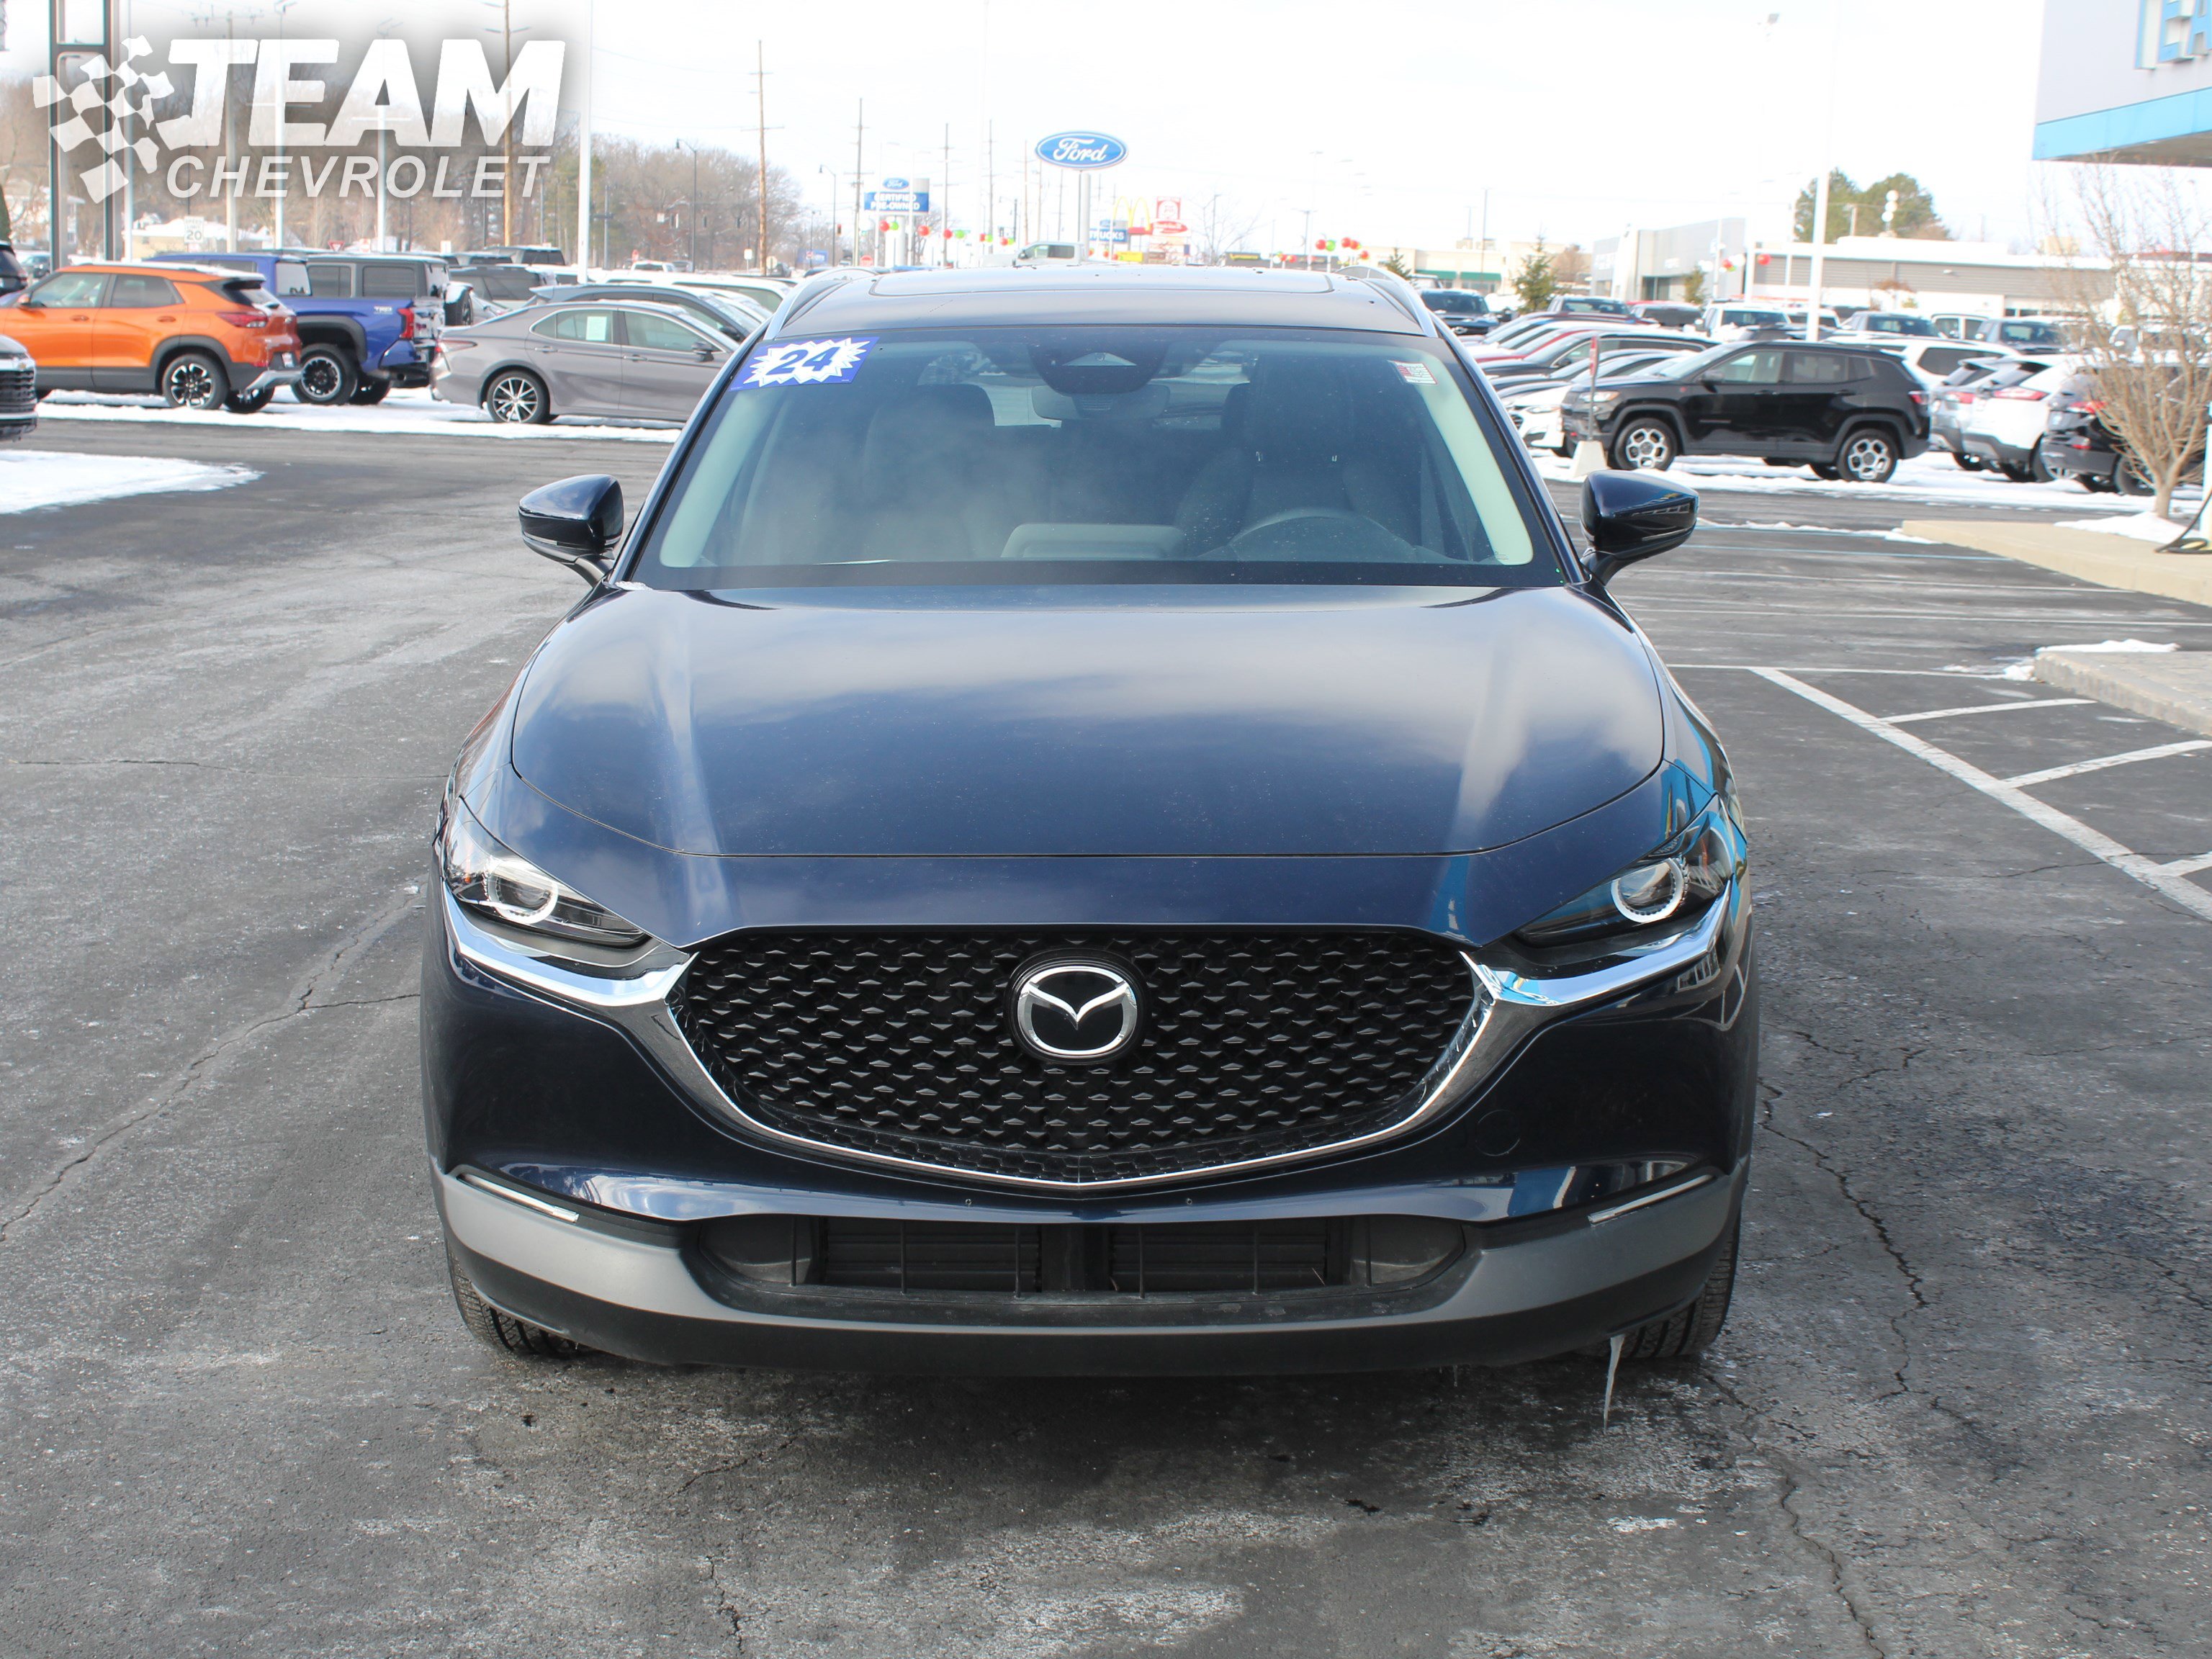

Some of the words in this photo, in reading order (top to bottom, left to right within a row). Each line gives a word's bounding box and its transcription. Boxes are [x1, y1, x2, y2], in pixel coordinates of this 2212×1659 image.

[1053, 137, 1109, 161] Ford
[870, 202, 920, 210] PE-OWND
[186, 230, 202, 240] 20
[765, 346, 841, 375] 24
